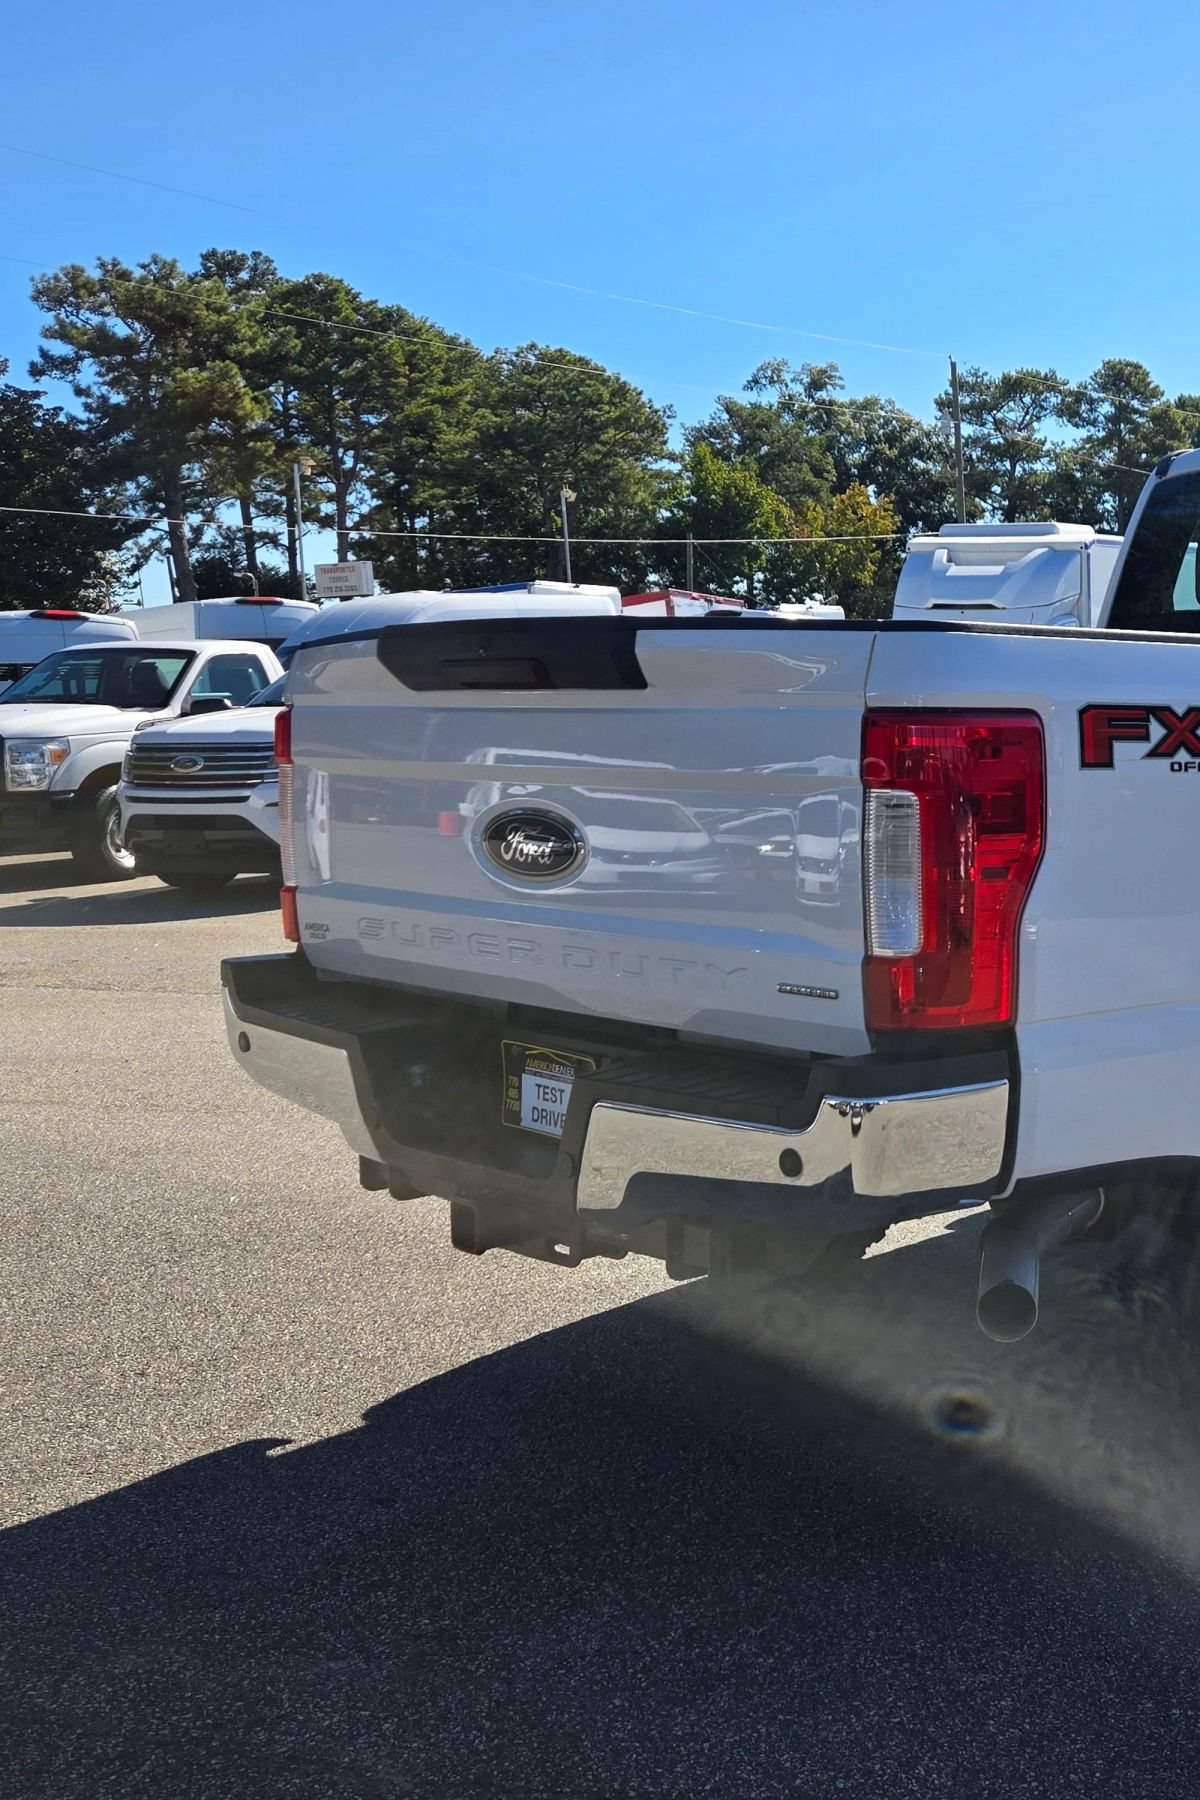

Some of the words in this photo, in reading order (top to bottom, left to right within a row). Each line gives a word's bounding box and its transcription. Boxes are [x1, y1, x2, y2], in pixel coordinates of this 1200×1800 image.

[501, 823, 572, 865] Ford
[357, 916, 544, 966] SUPER
[562, 944, 748, 990] DUTY
[535, 1083, 566, 1105] TEST
